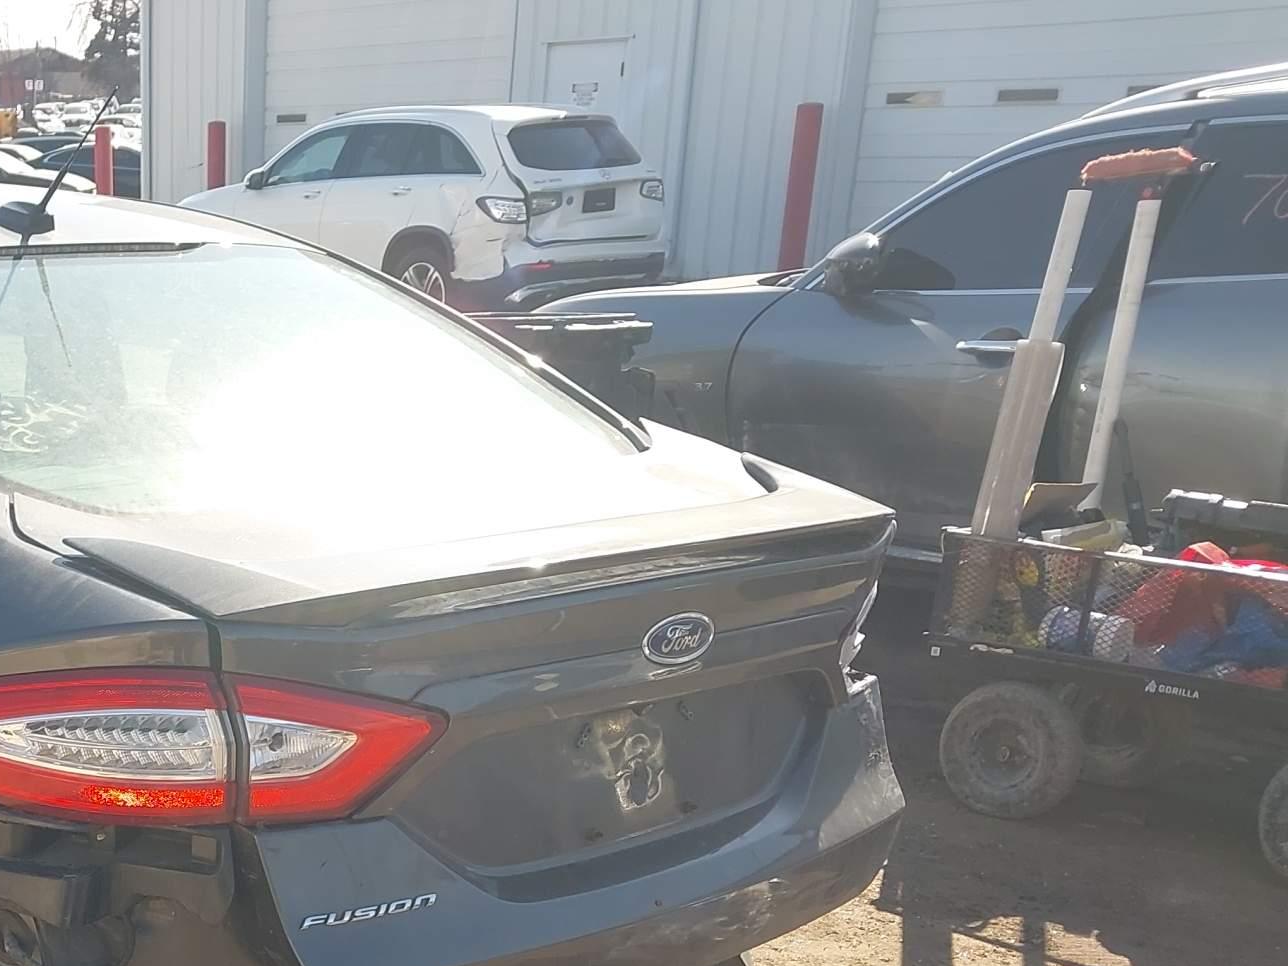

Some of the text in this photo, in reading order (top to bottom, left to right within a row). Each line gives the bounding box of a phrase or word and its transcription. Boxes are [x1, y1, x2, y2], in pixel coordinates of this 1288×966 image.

[661, 623, 702, 654] Ford
[1158, 684, 1200, 699] GORILLA
[300, 893, 438, 931] FUSION
